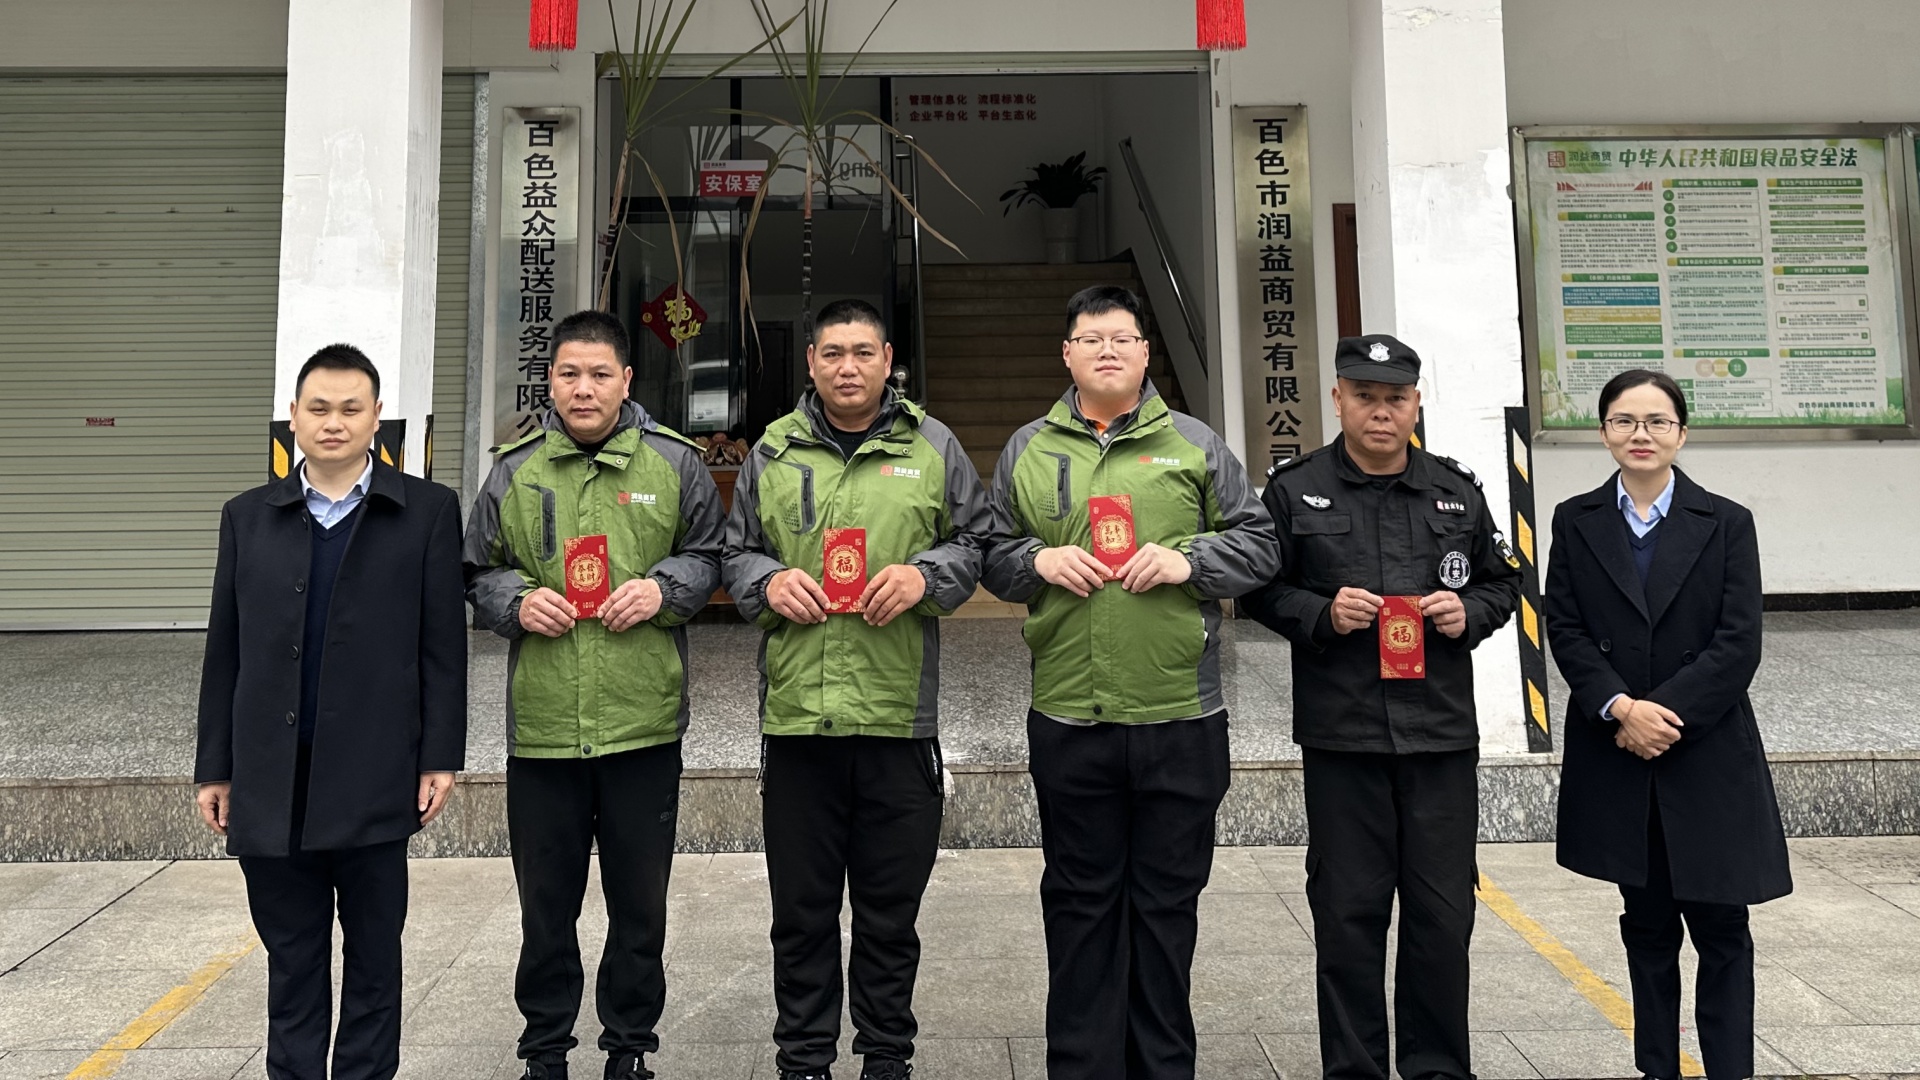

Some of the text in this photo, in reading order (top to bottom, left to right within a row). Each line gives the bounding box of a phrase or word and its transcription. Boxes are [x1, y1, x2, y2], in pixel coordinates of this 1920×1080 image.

[909, 94, 967, 106] 管理信息化
[978, 93, 1036, 105] 流程标准化
[909, 110, 968, 122] 企业平台化
[978, 109, 1037, 121] 平台生态化
[1619, 147, 1858, 168] 中华人民共和国食品安全法
[705, 174, 762, 193] 安保室
[1252, 118, 1302, 465] 百色市润益商贸有限公司
[836, 556, 853, 573] 福
[1391, 625, 1412, 643] 福
